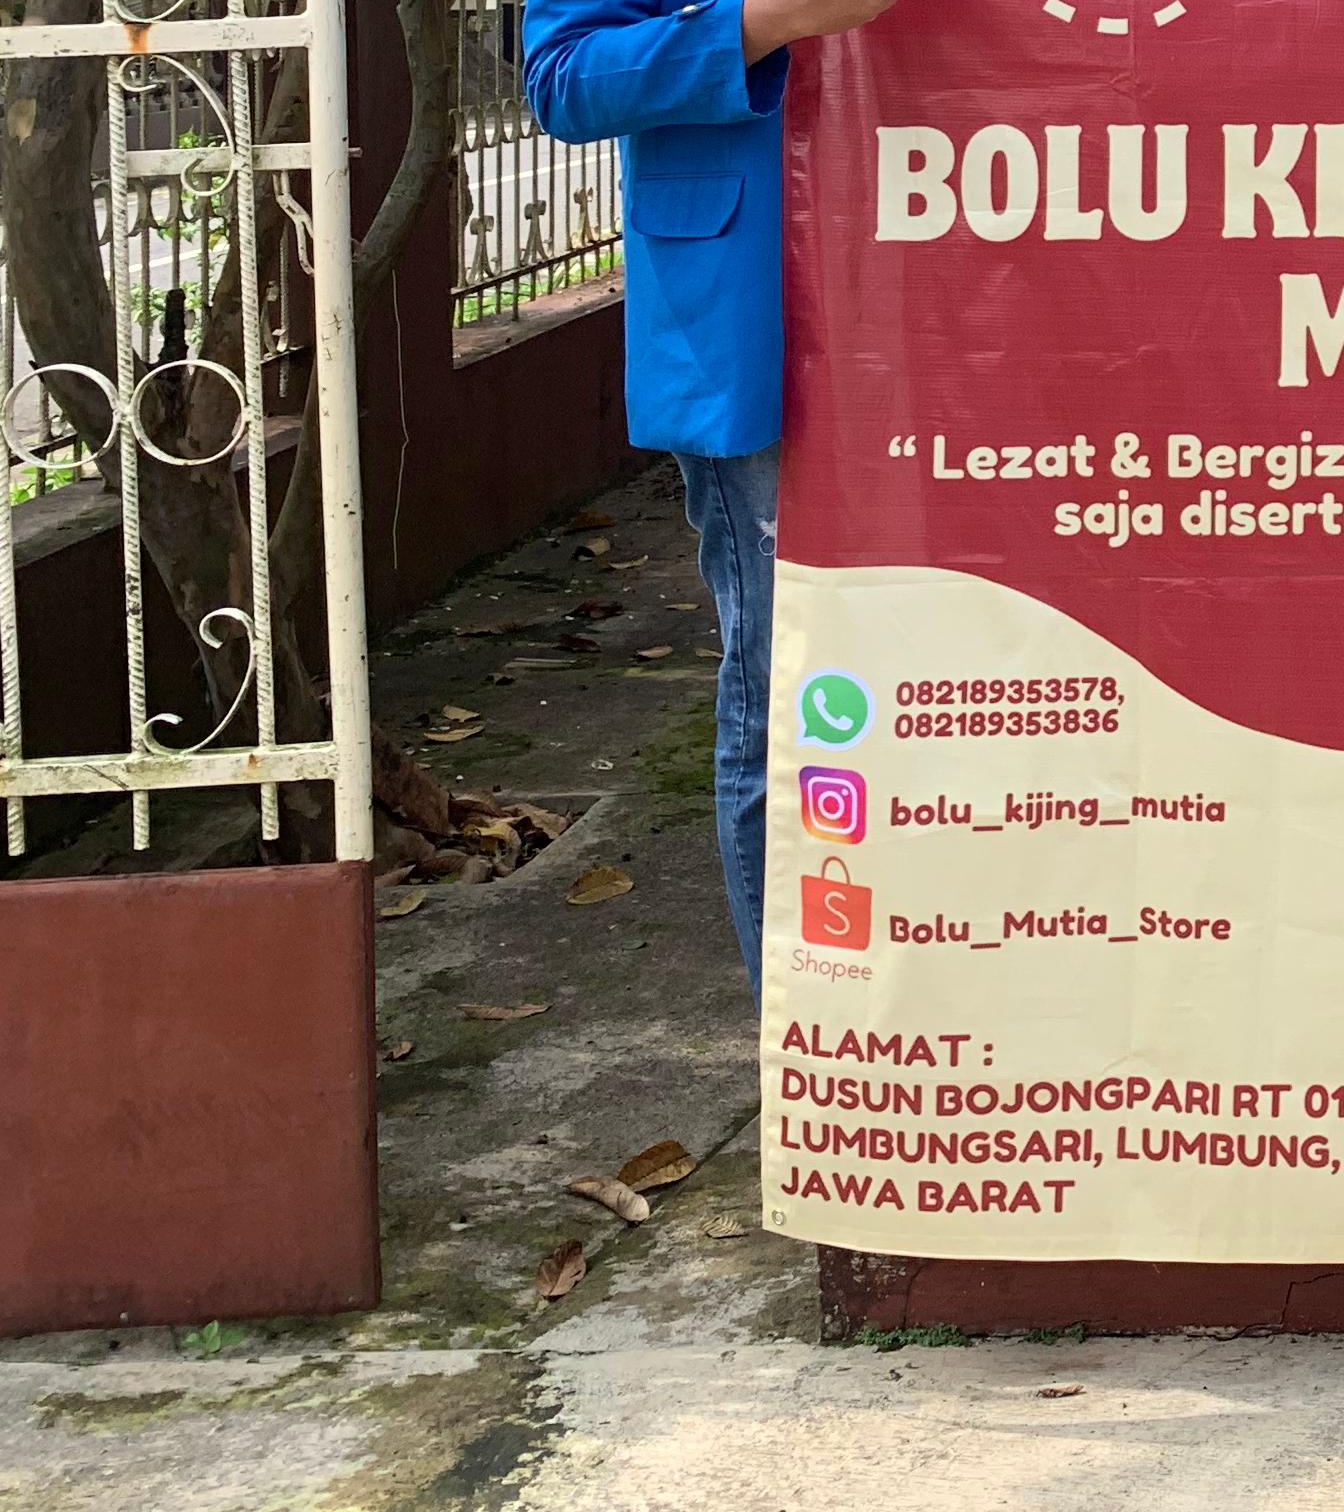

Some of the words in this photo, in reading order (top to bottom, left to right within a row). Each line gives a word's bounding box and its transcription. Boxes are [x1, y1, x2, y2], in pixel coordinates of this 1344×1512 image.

[874, 123, 1189, 242] BOLU
[933, 435, 1095, 480] Lezat
[1110, 432, 1151, 479] &
[1055, 489, 1164, 547] saja
[896, 676, 1126, 707] 082189353578,
[893, 708, 1119, 739] 082189353836
[790, 949, 873, 982] Shopee
[782, 1021, 971, 1068] ALAMAT
[984, 1044, 993, 1065] :
[780, 1067, 922, 1115] DUSUN
[936, 1076, 1220, 1116] BOJONGPARI
[1232, 1083, 1291, 1117] RT
[779, 1117, 1102, 1168] LUMBUNGSARI,
[1117, 1127, 1340, 1171] LUMBUNG,
[783, 1168, 905, 1209] JAWA
[918, 1179, 1075, 1213] BARAT
